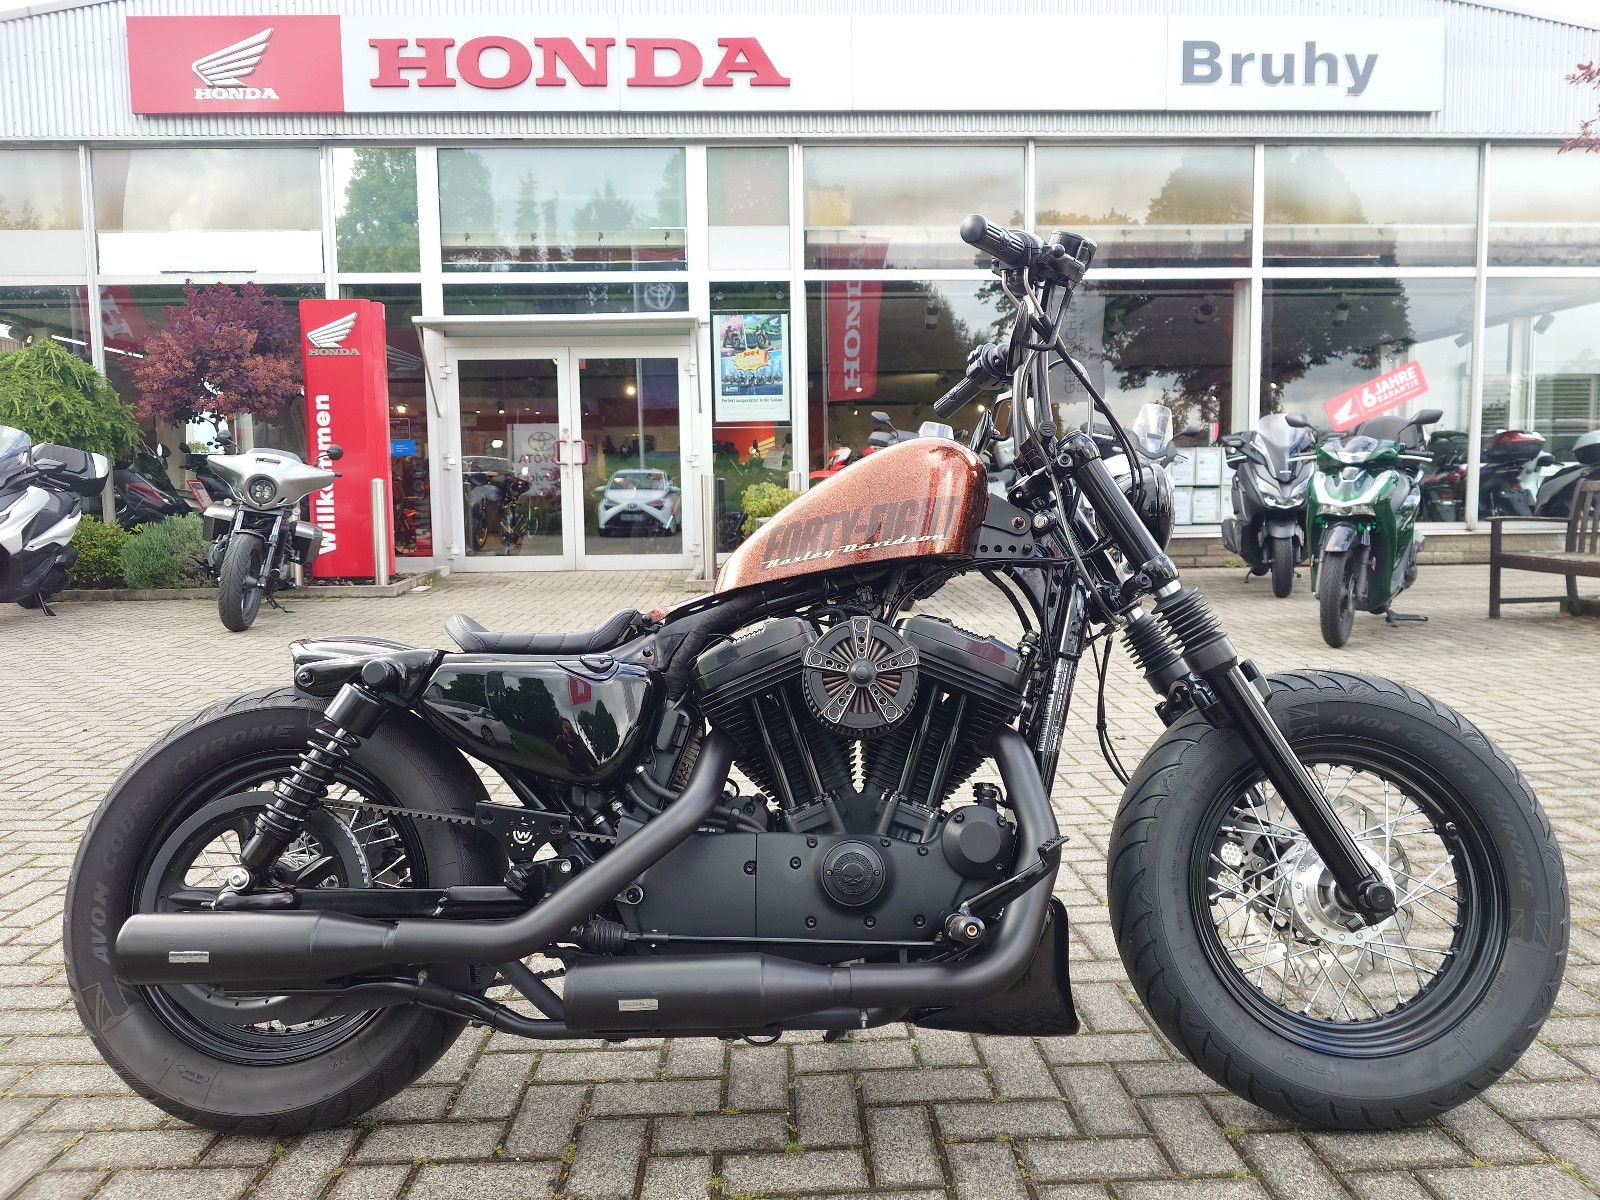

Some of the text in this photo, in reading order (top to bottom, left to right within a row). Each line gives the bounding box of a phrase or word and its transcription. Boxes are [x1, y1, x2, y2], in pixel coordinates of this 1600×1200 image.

[368, 35, 791, 89] HONDA
[1180, 39, 1379, 97] Bruhy
[193, 87, 280, 100] HONDA
[308, 348, 361, 356] HONDA
[1362, 366, 1417, 408] 6 JAHRE
[1377, 378, 1420, 402] GARANTIE
[315, 394, 337, 555] Willkmmen
[762, 533, 952, 570] Harley-Davidson
[1331, 713, 1400, 733] AVON
[1487, 791, 1535, 897] CHROME
[91, 880, 111, 967] AVON
[175, 722, 298, 776] CHROME
